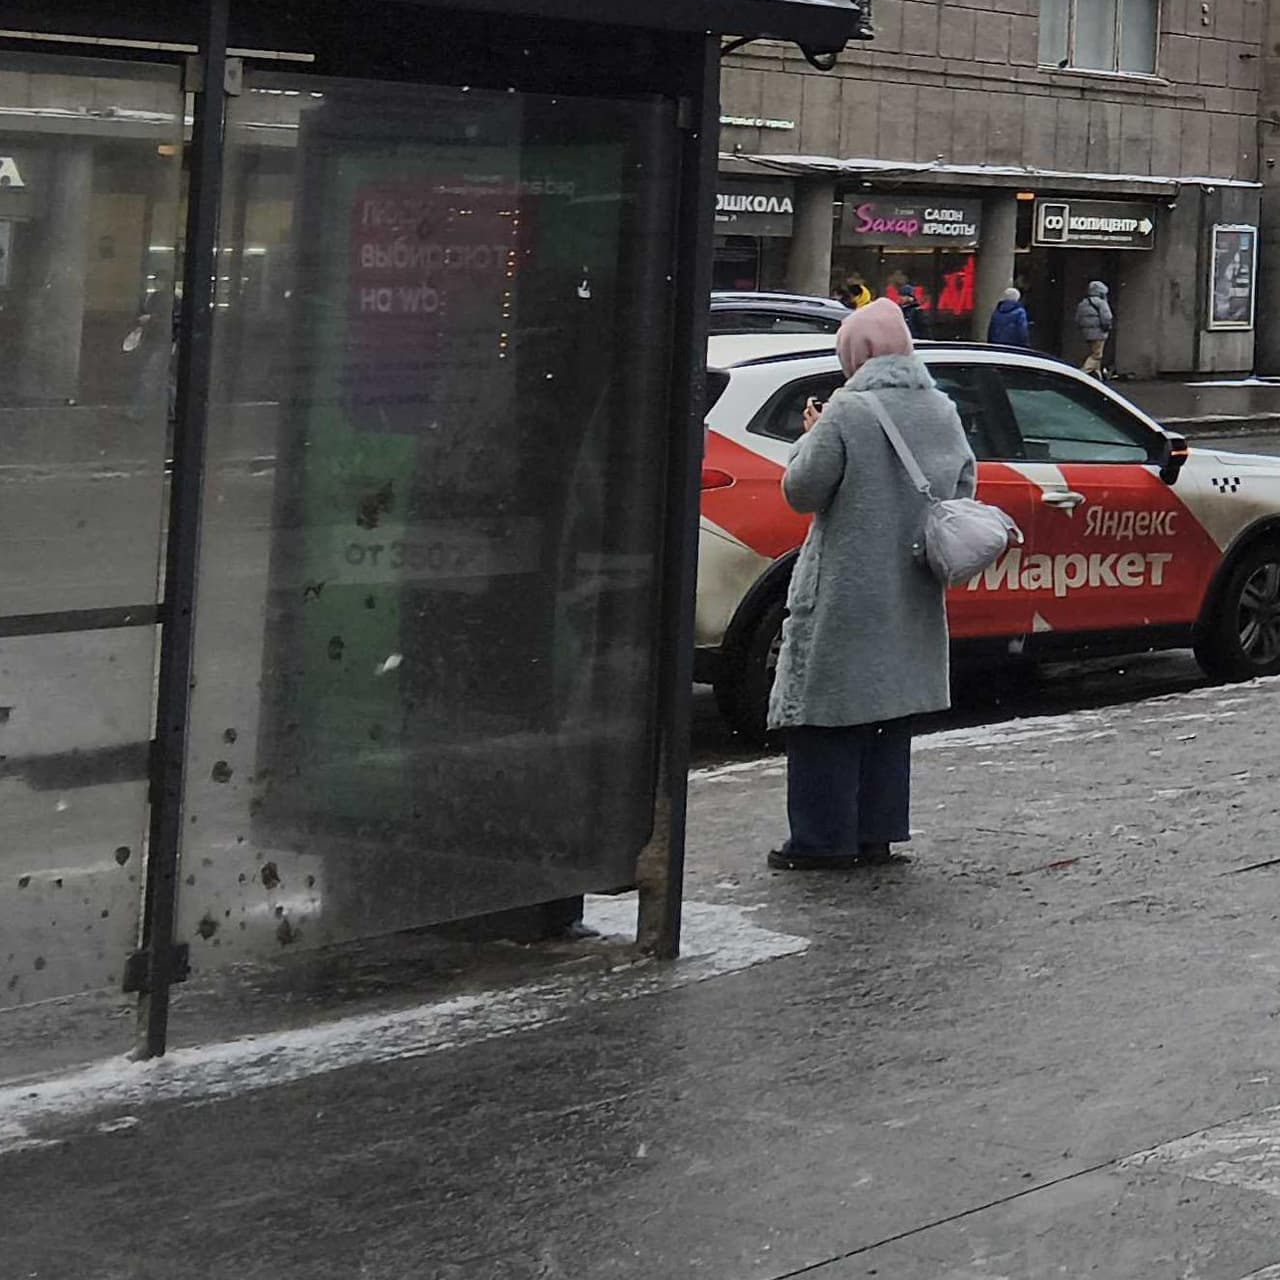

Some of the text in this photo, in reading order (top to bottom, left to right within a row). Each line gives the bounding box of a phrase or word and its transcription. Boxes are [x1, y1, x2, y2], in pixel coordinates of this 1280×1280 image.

[924, 208, 963, 222] САЛОН
[921, 223, 976, 237] КРАСОТЫ
[1069, 217, 1137, 232] КОПИЦЕНТР
[1084, 505, 1178, 541] Яндекс
[967, 548, 1173, 597] Маркет
